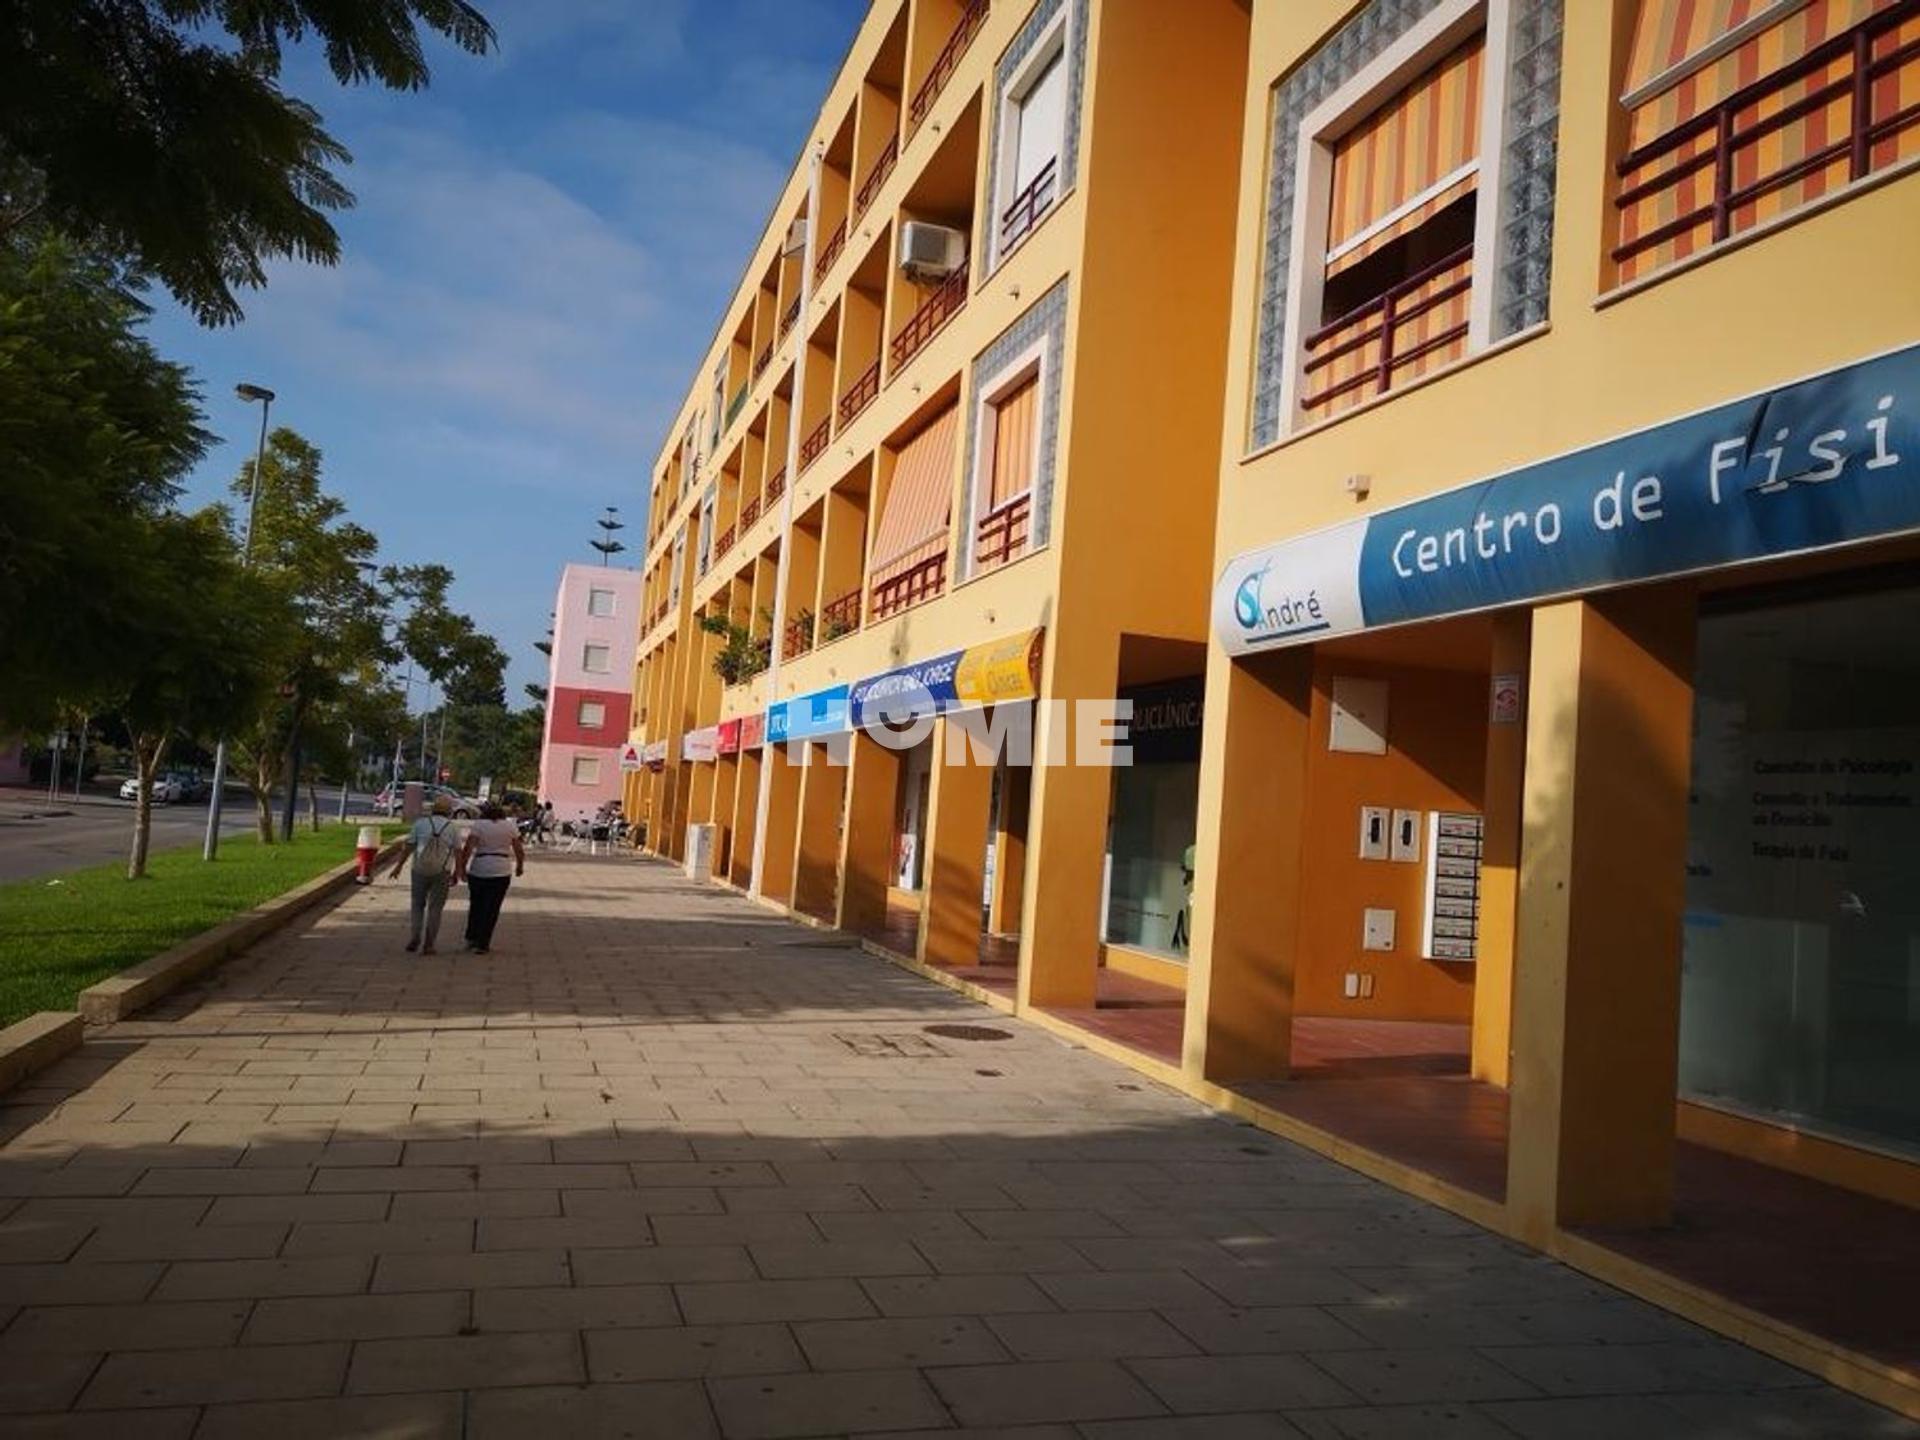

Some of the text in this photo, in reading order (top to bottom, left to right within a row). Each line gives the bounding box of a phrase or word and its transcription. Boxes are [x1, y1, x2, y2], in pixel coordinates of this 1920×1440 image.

[1393, 395, 1899, 578] Centro de Fisi
